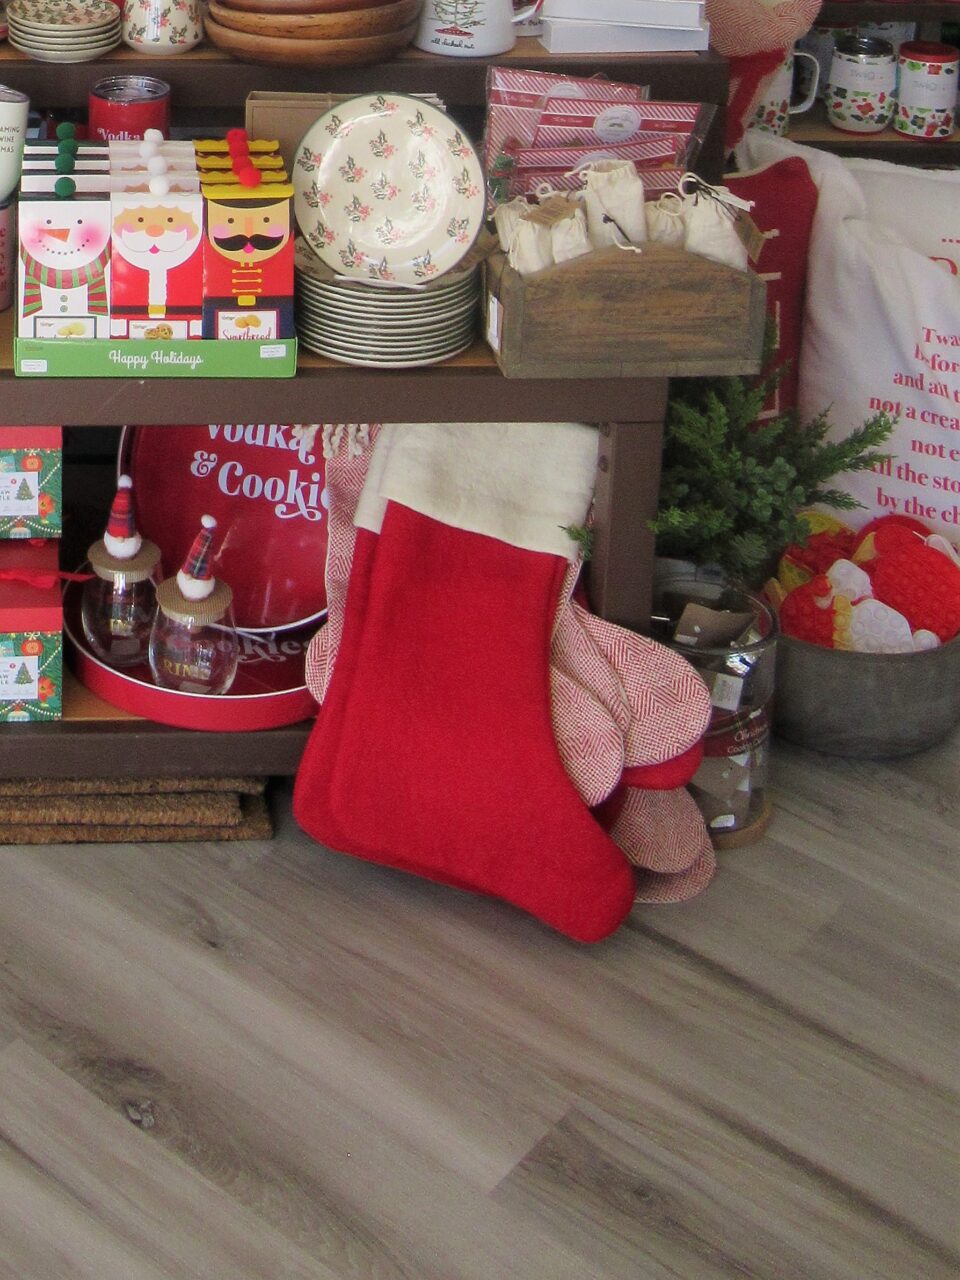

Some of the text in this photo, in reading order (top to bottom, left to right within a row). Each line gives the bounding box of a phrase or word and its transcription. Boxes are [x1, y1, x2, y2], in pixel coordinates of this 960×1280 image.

[108, 350, 204, 370] Happy Holidays
[893, 371, 950, 399] and all
[906, 405, 917, 420] a
[911, 438, 946, 459] not
[191, 450, 218, 478] &
[897, 462, 929, 487] the
[876, 486, 900, 514] by
[904, 496, 937, 520] the
